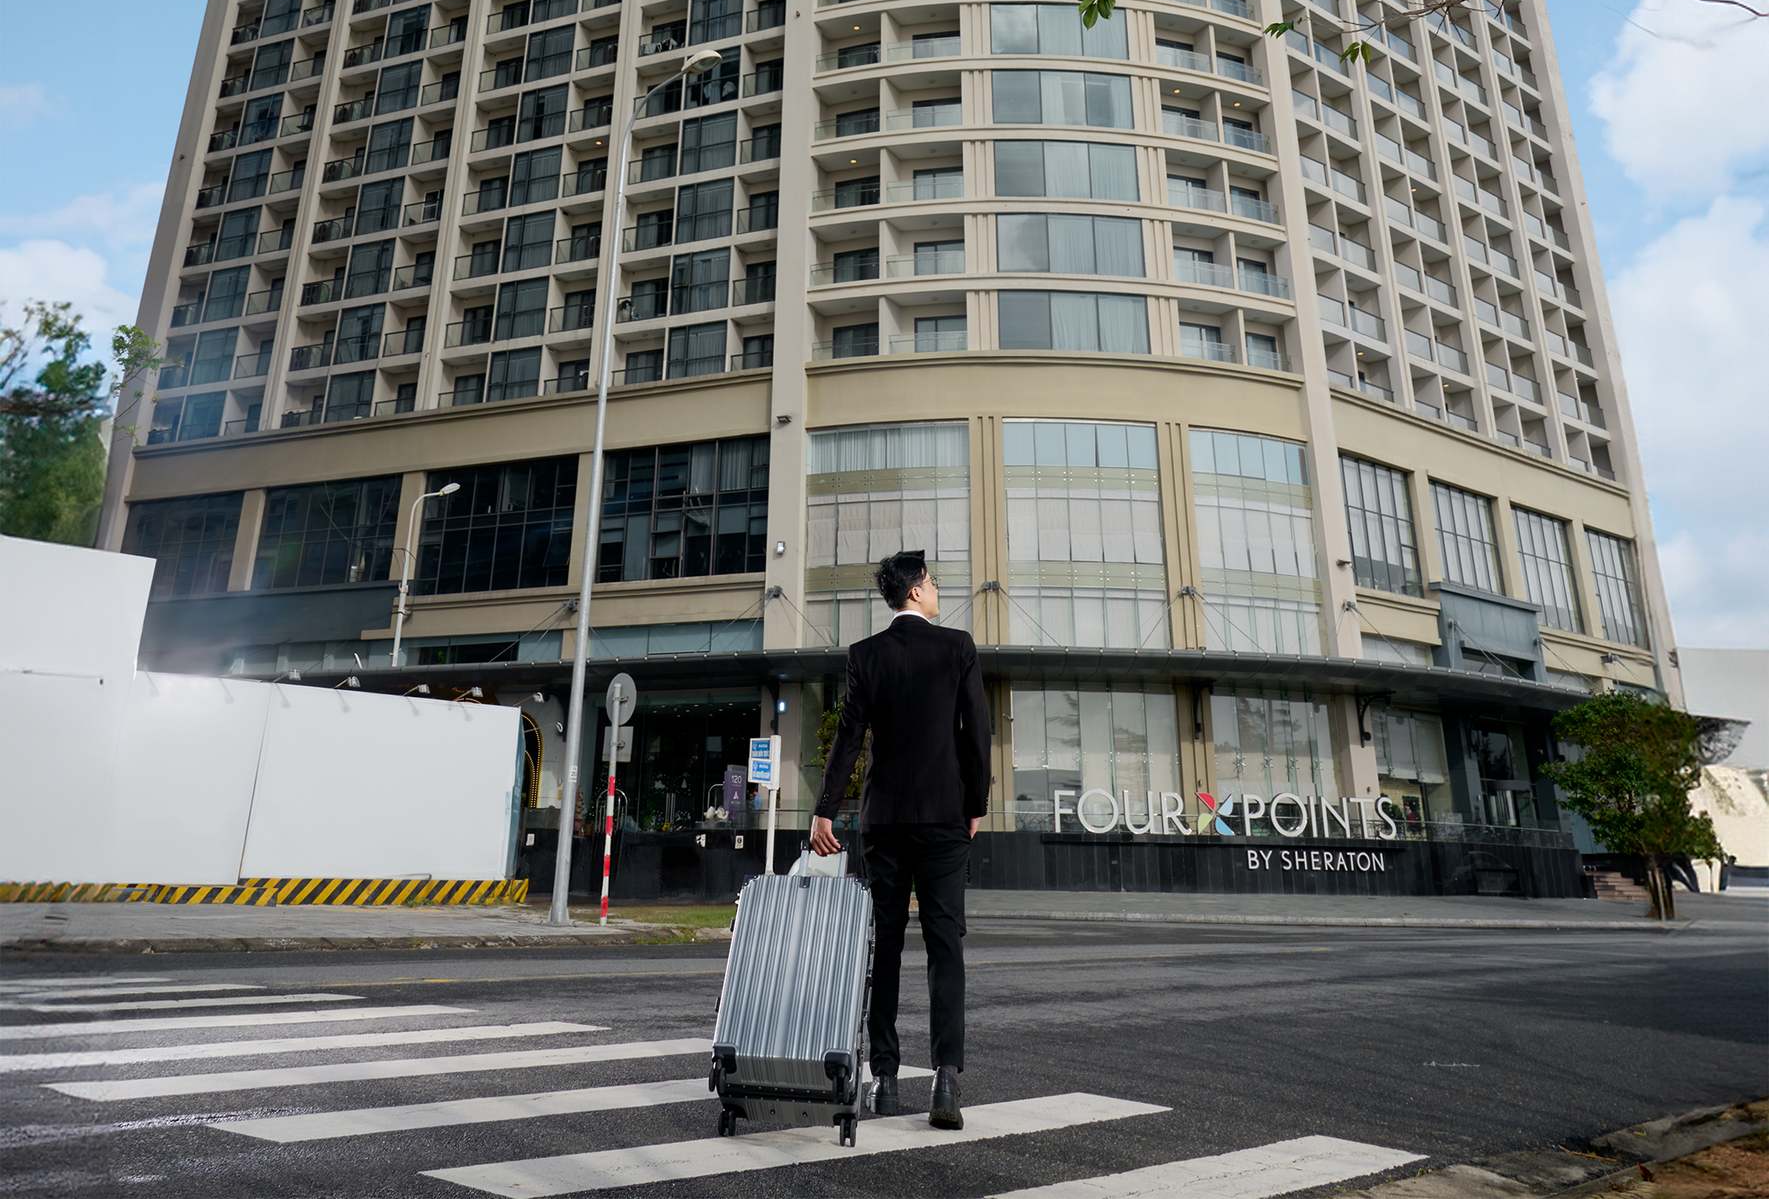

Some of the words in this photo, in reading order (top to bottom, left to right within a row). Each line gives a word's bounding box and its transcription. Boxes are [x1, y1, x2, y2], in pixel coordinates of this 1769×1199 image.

[731, 775, 742, 784] 120
[1053, 788, 1193, 835] FOUR
[1241, 792, 1398, 841] POINTS
[1247, 850, 1272, 870] BY
[1281, 850, 1386, 872] SHERATON
